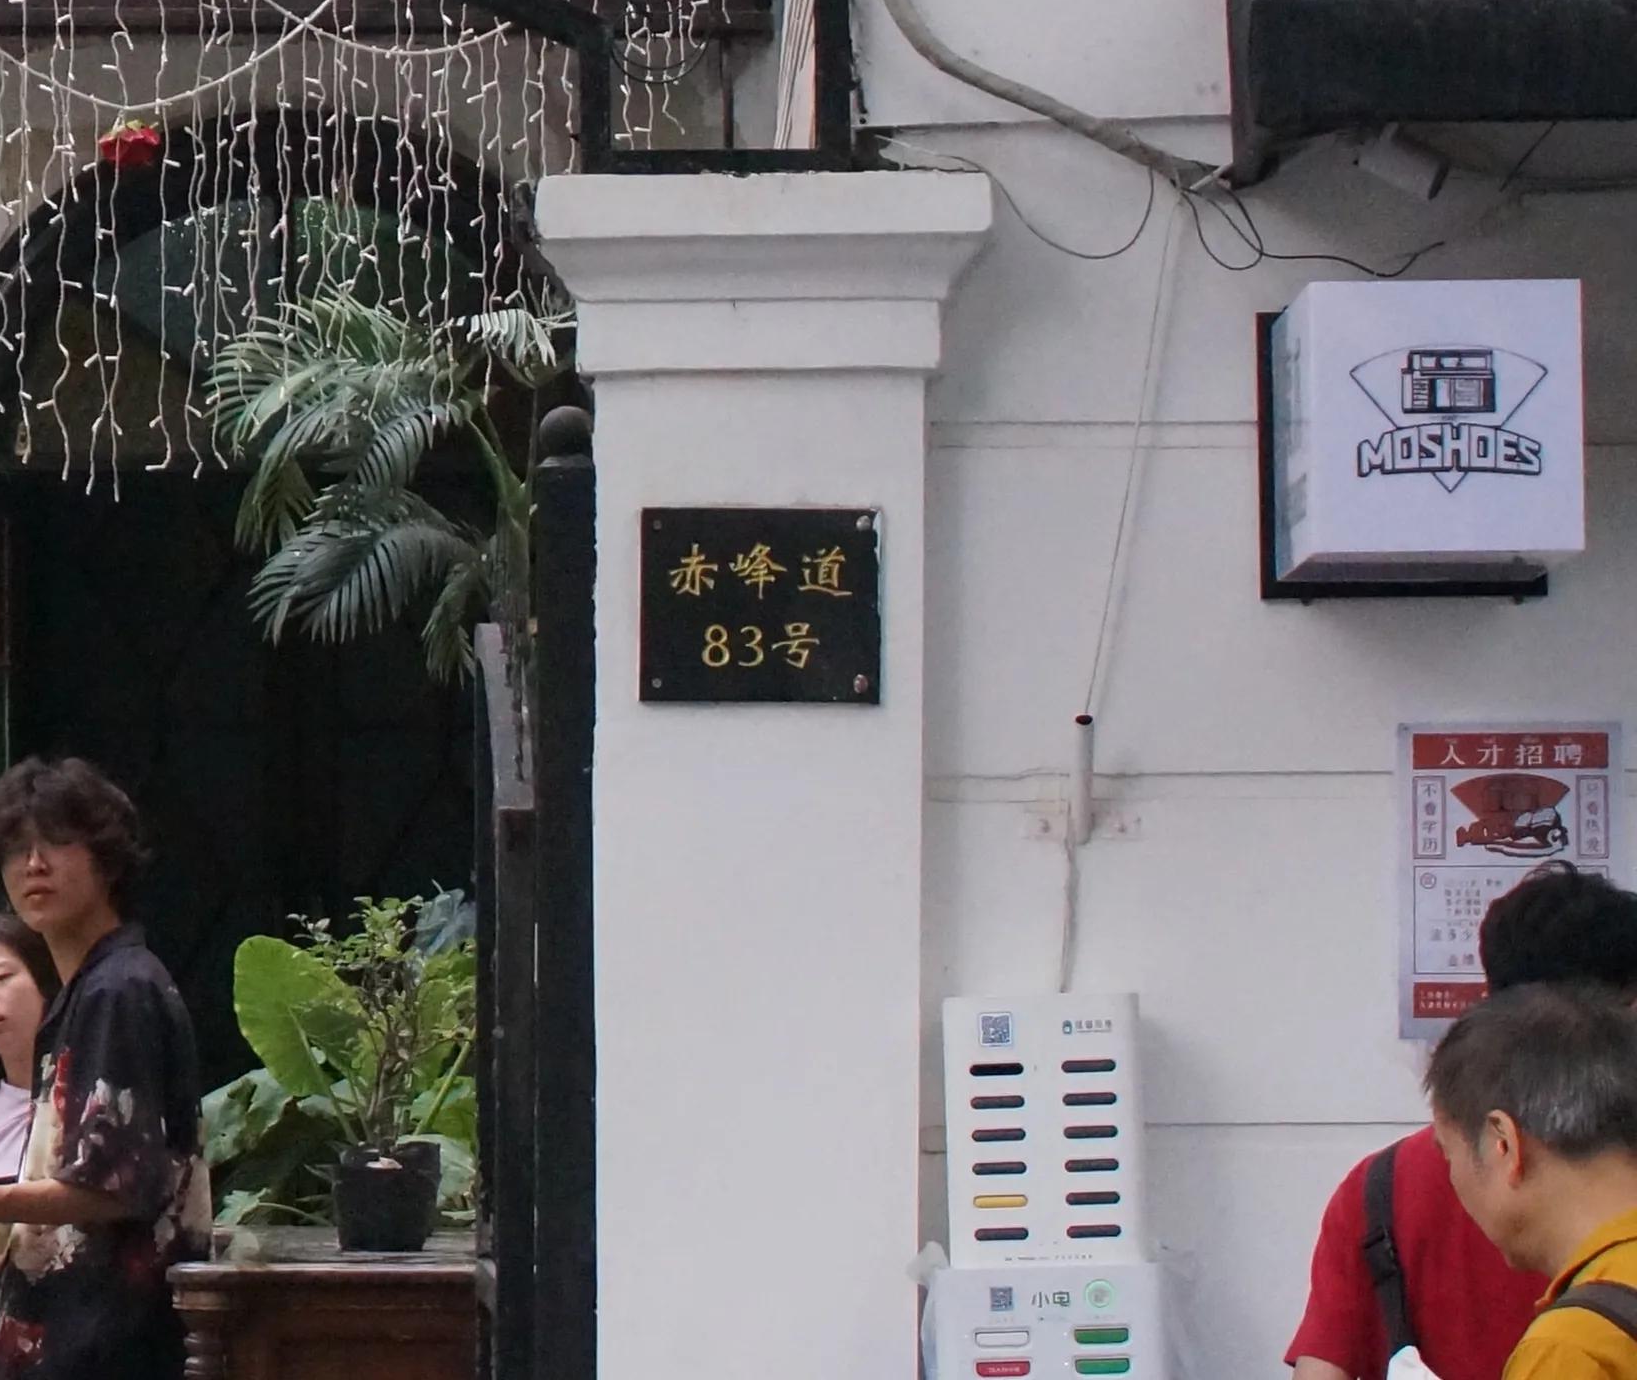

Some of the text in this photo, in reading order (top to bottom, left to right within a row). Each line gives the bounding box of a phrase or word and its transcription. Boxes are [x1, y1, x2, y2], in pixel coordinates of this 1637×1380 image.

[1357, 422, 1541, 478] MOSHOES
[668, 542, 853, 599] 赤峰道
[701, 623, 821, 671] 83号
[1440, 744, 1583, 766] 人才招聘
